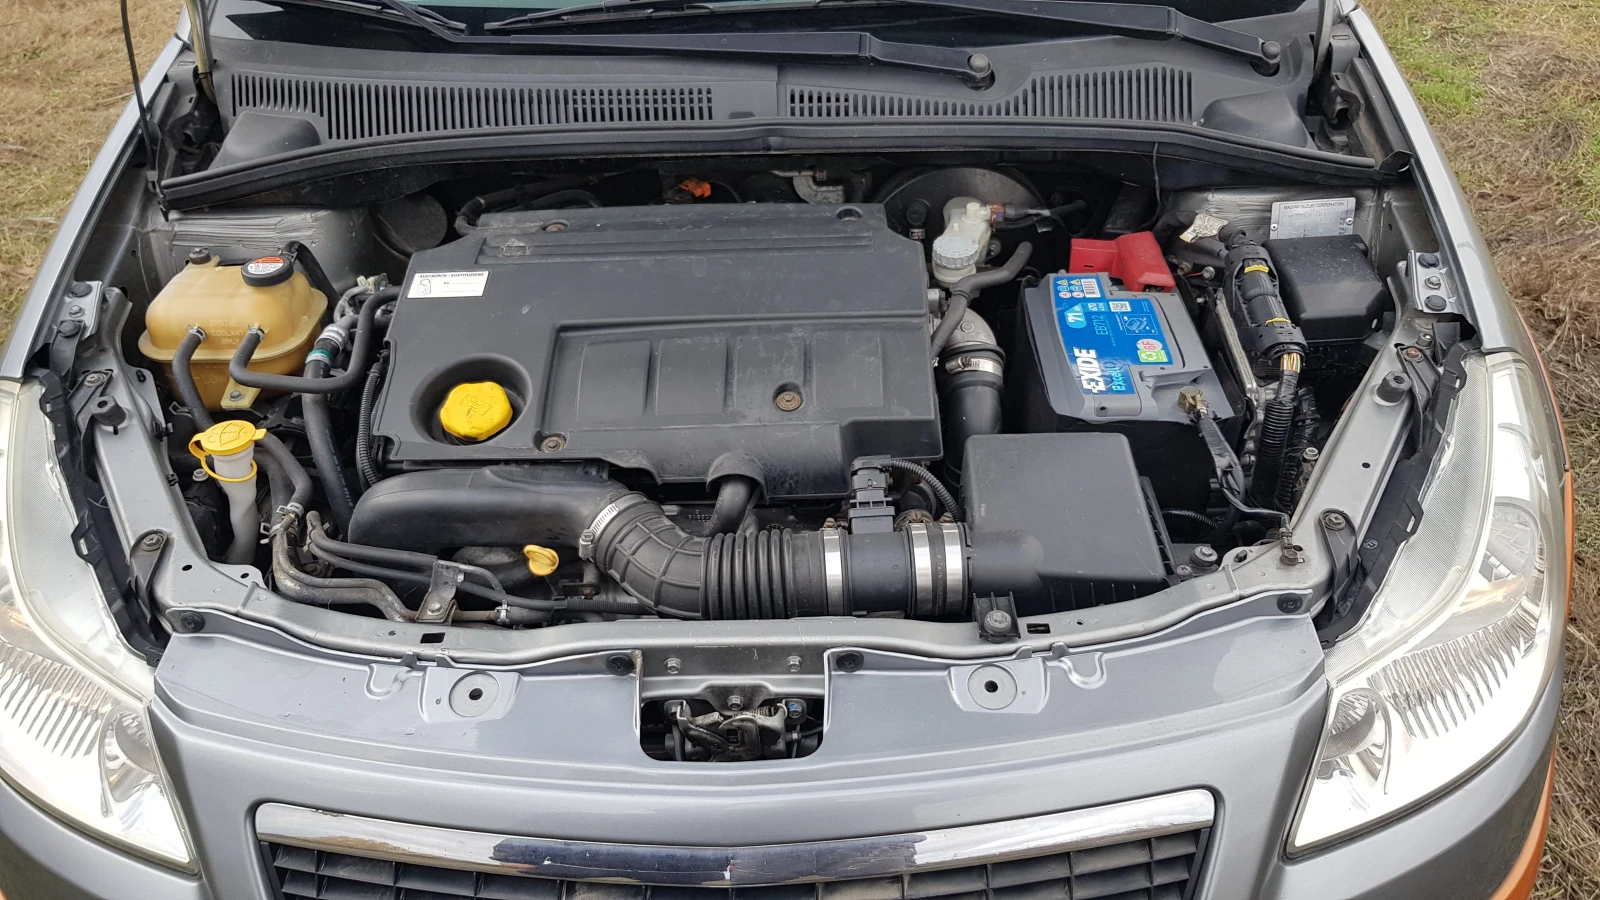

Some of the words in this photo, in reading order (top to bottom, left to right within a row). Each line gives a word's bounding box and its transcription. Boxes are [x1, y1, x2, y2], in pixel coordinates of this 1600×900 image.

[1066, 312, 1084, 323] 71
[1091, 315, 1109, 335] EB712
[211, 329, 244, 337] COOLANT
[1073, 347, 1106, 393] EXIDE
[1106, 367, 1127, 391] Excell
